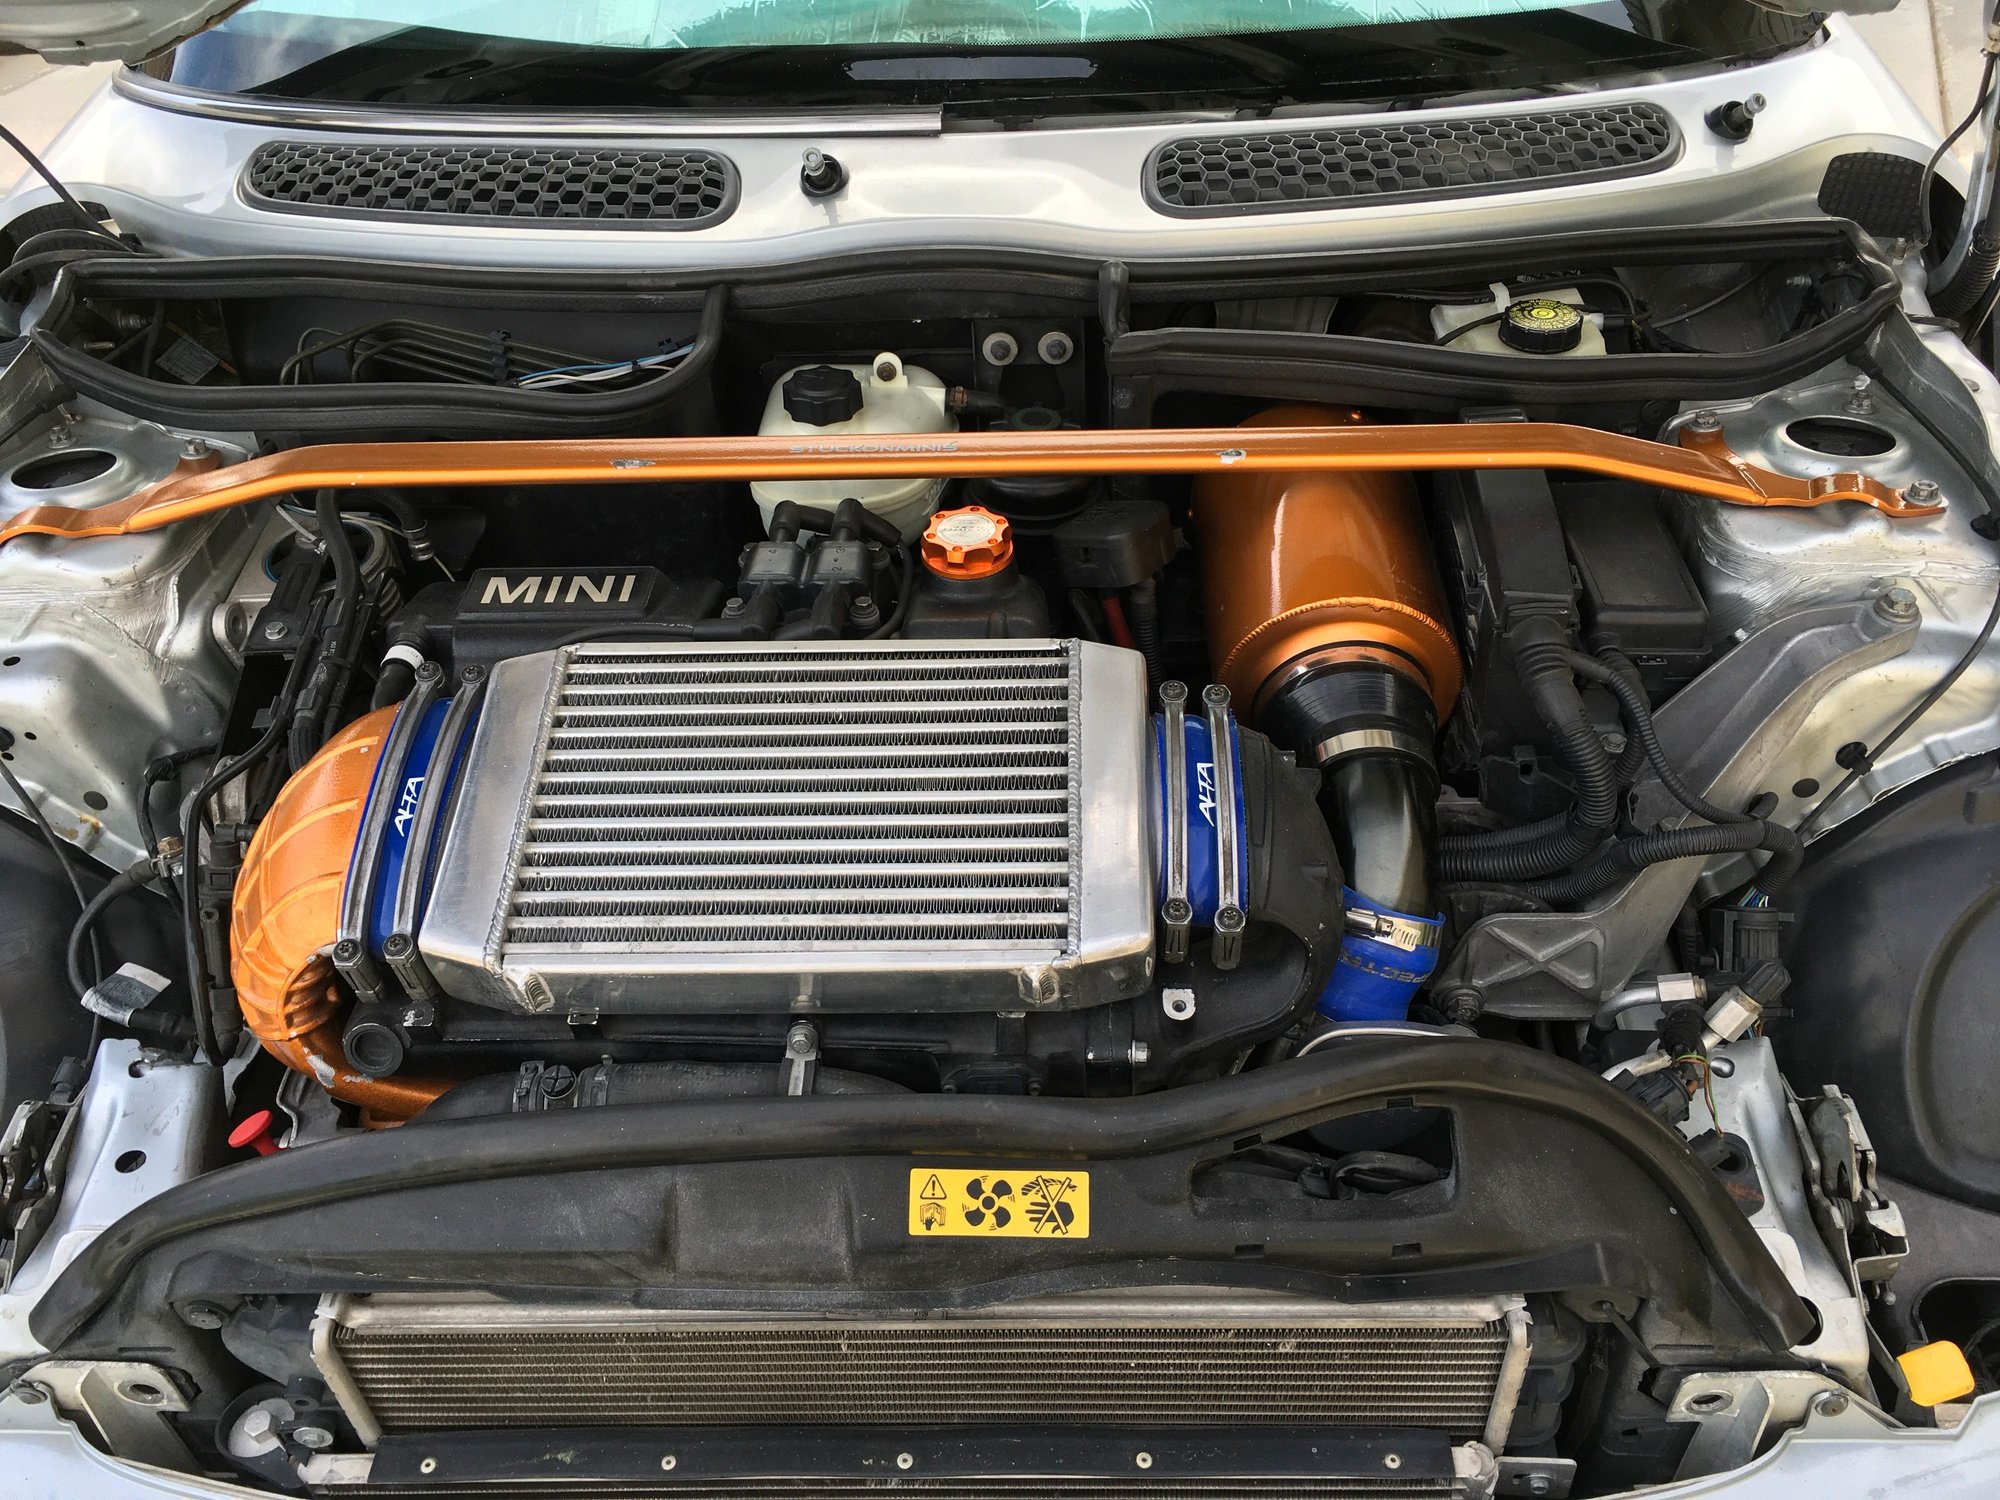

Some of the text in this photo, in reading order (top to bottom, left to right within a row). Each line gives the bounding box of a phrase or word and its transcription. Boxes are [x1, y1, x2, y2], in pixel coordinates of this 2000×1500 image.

[480, 575, 636, 604] MINI
[394, 776, 426, 837] ALTA
[1196, 762, 1216, 828] ALTA
